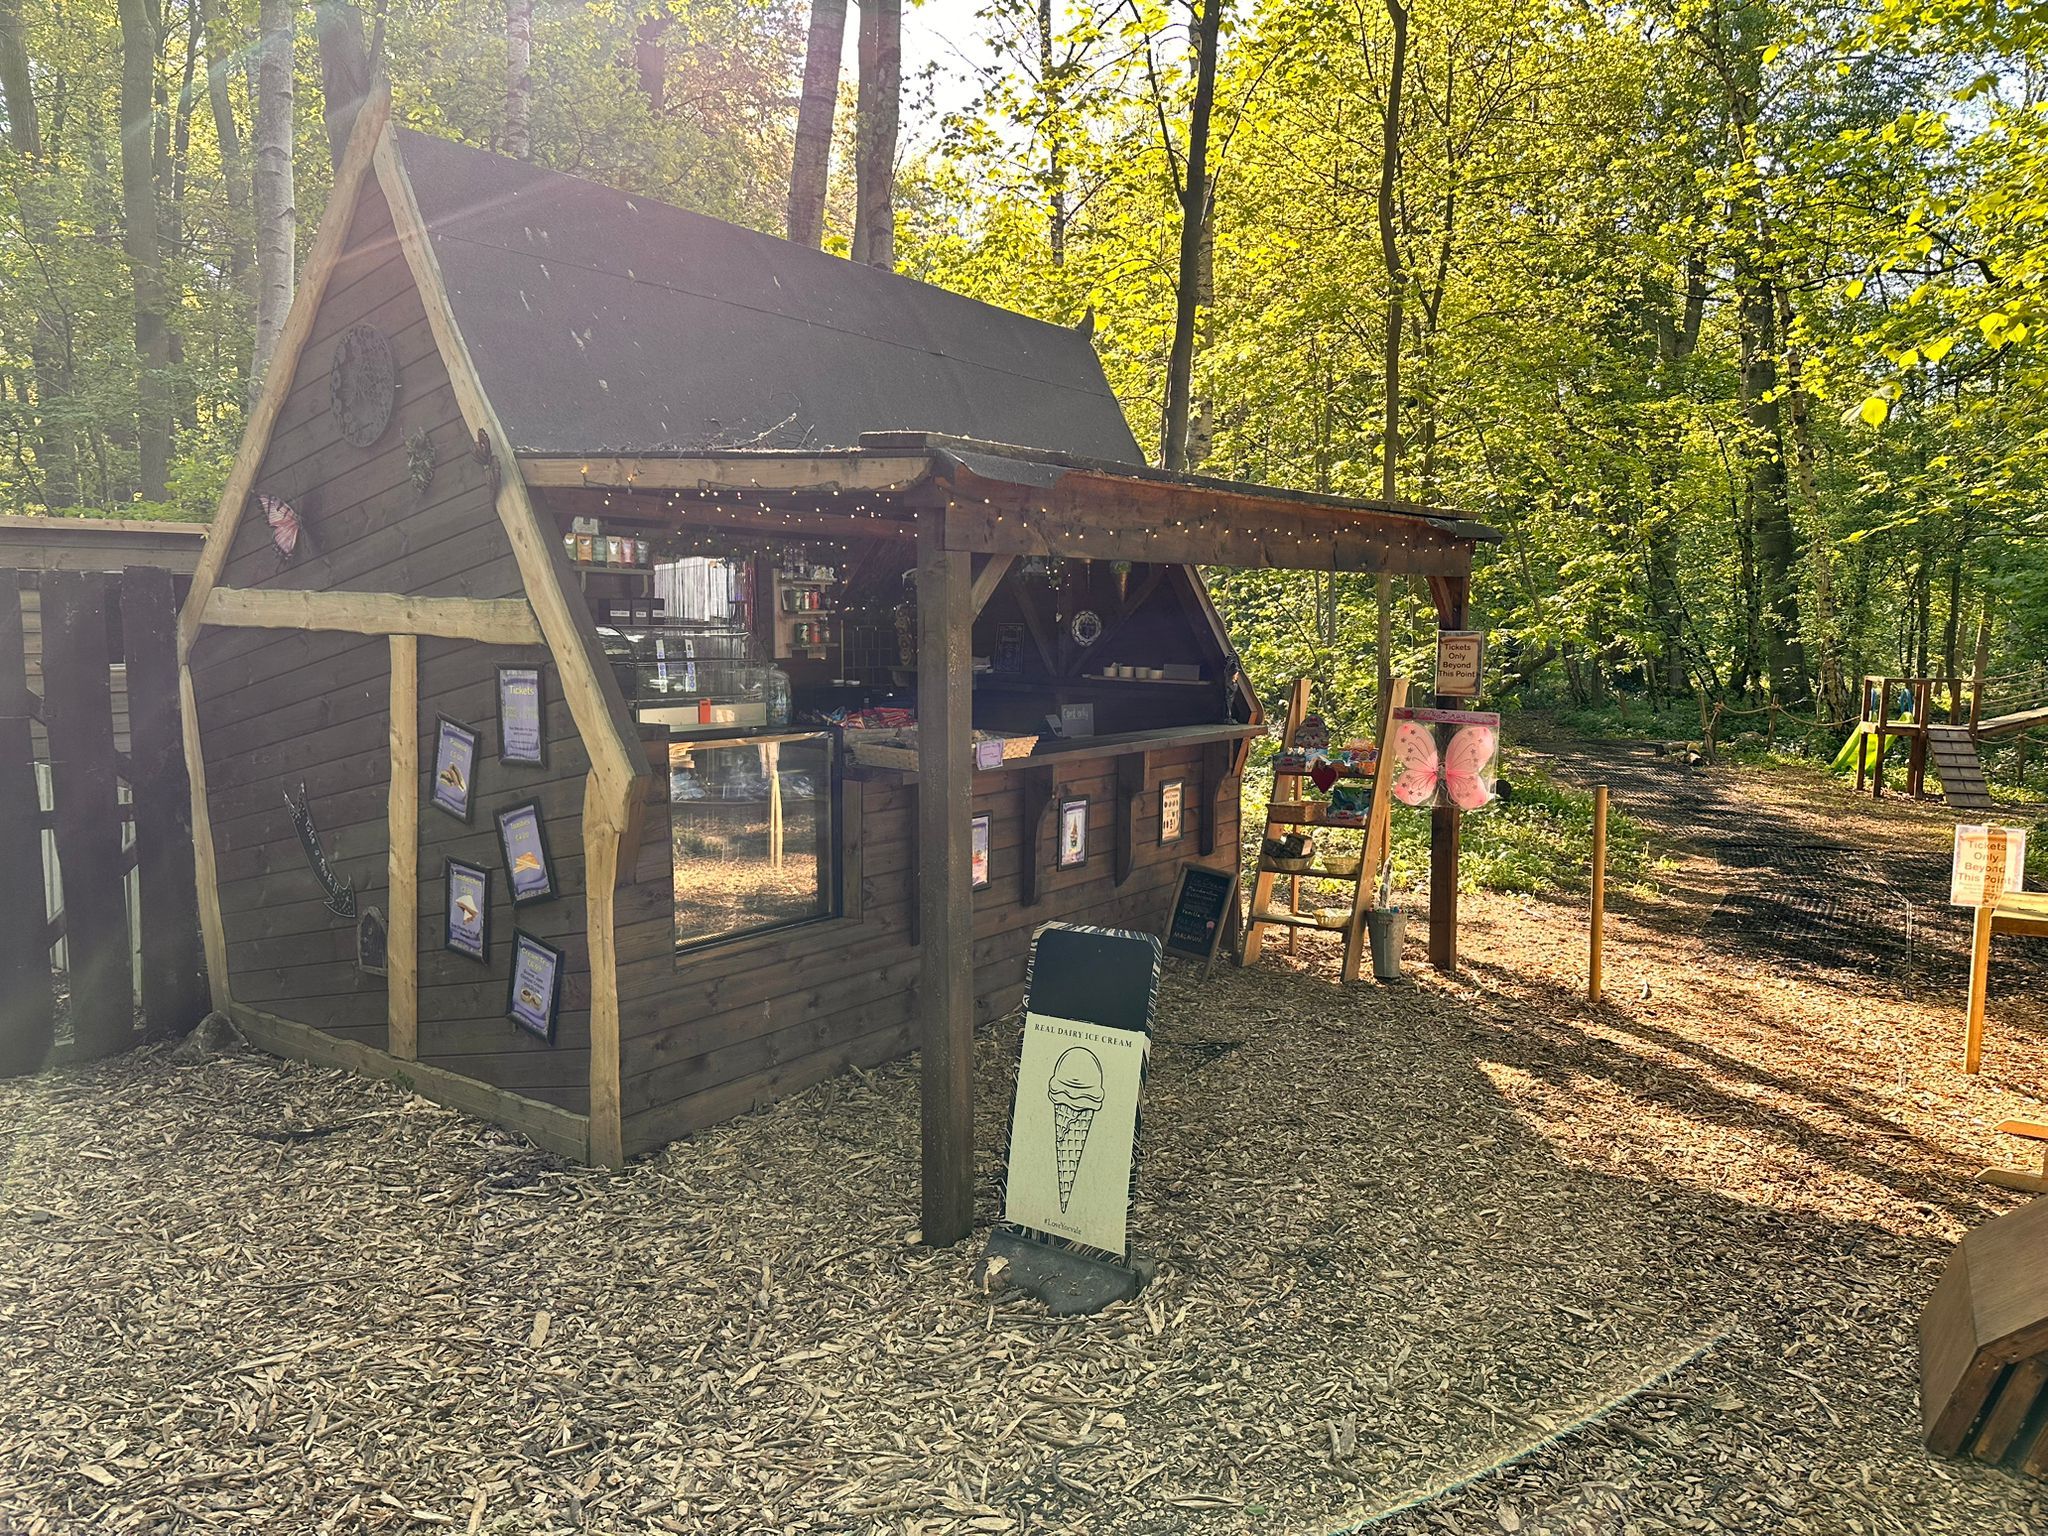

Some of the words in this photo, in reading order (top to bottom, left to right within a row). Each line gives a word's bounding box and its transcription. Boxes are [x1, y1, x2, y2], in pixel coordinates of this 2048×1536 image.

[1445, 643, 1471, 651] Tickets
[1448, 652, 1466, 660] Only
[509, 685, 535, 696] Tickets
[1968, 840, 2006, 851] Tickets
[1973, 851, 1999, 863] Only
[1964, 862, 2006, 874] Beyond
[1957, 872, 1981, 882] This
[1984, 874, 2011, 885] Point
[1034, 1023, 1055, 1034] REAL
[1057, 1027, 1085, 1039] DAIRY
[1085, 1032, 1100, 1042] ICE
[1101, 1036, 1133, 1048] CREAM
